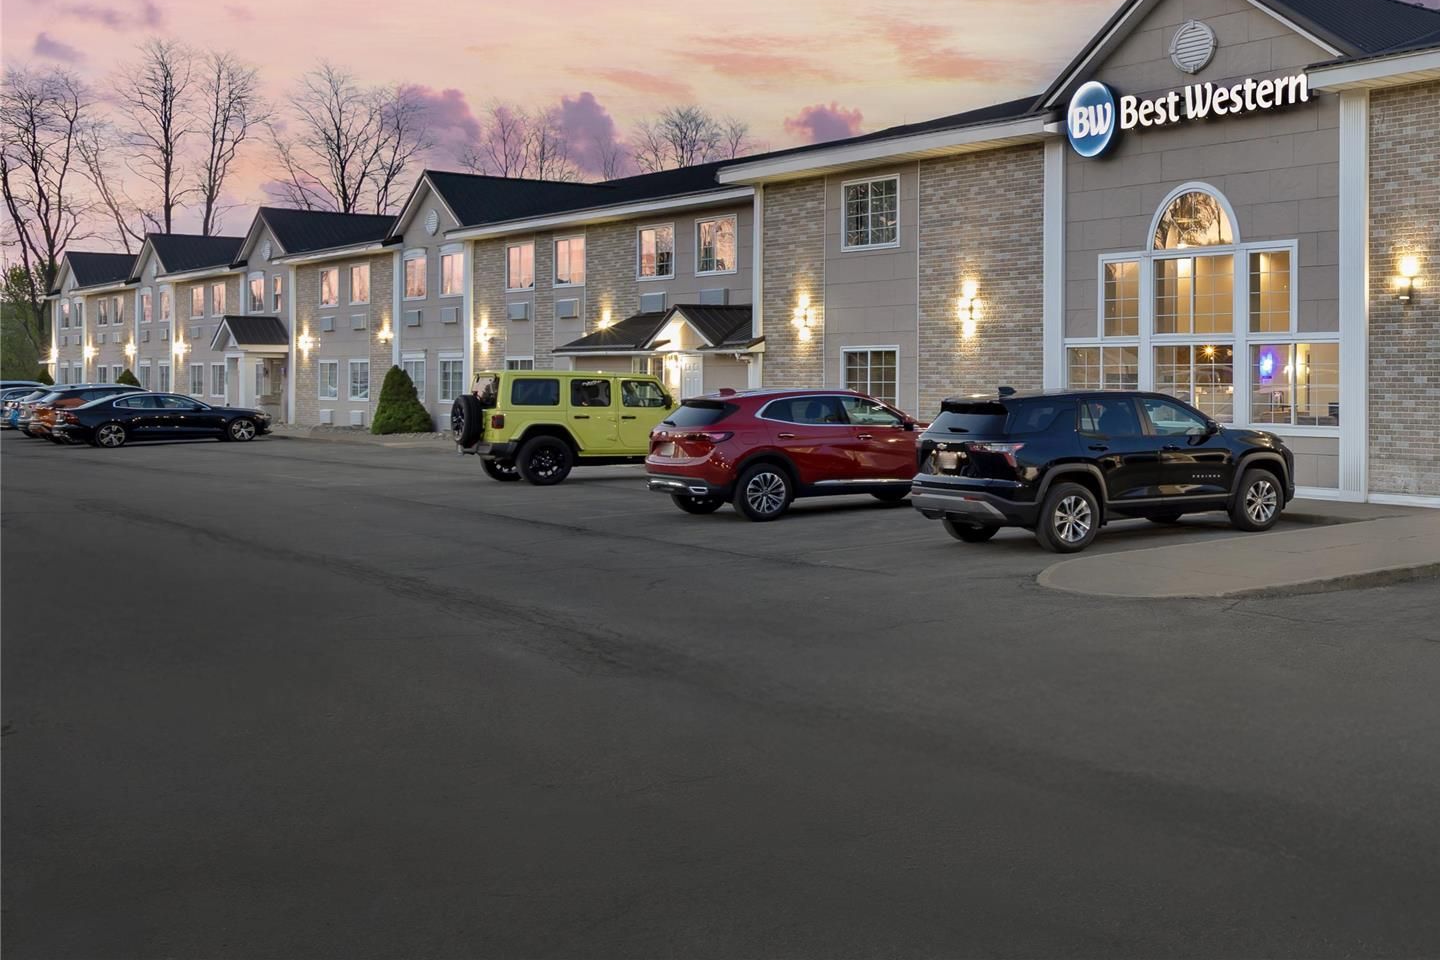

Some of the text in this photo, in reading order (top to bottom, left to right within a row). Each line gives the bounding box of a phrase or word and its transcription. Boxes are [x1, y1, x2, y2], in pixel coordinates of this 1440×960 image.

[1071, 102, 1112, 139] BW
[1120, 73, 1309, 130] Best Western
